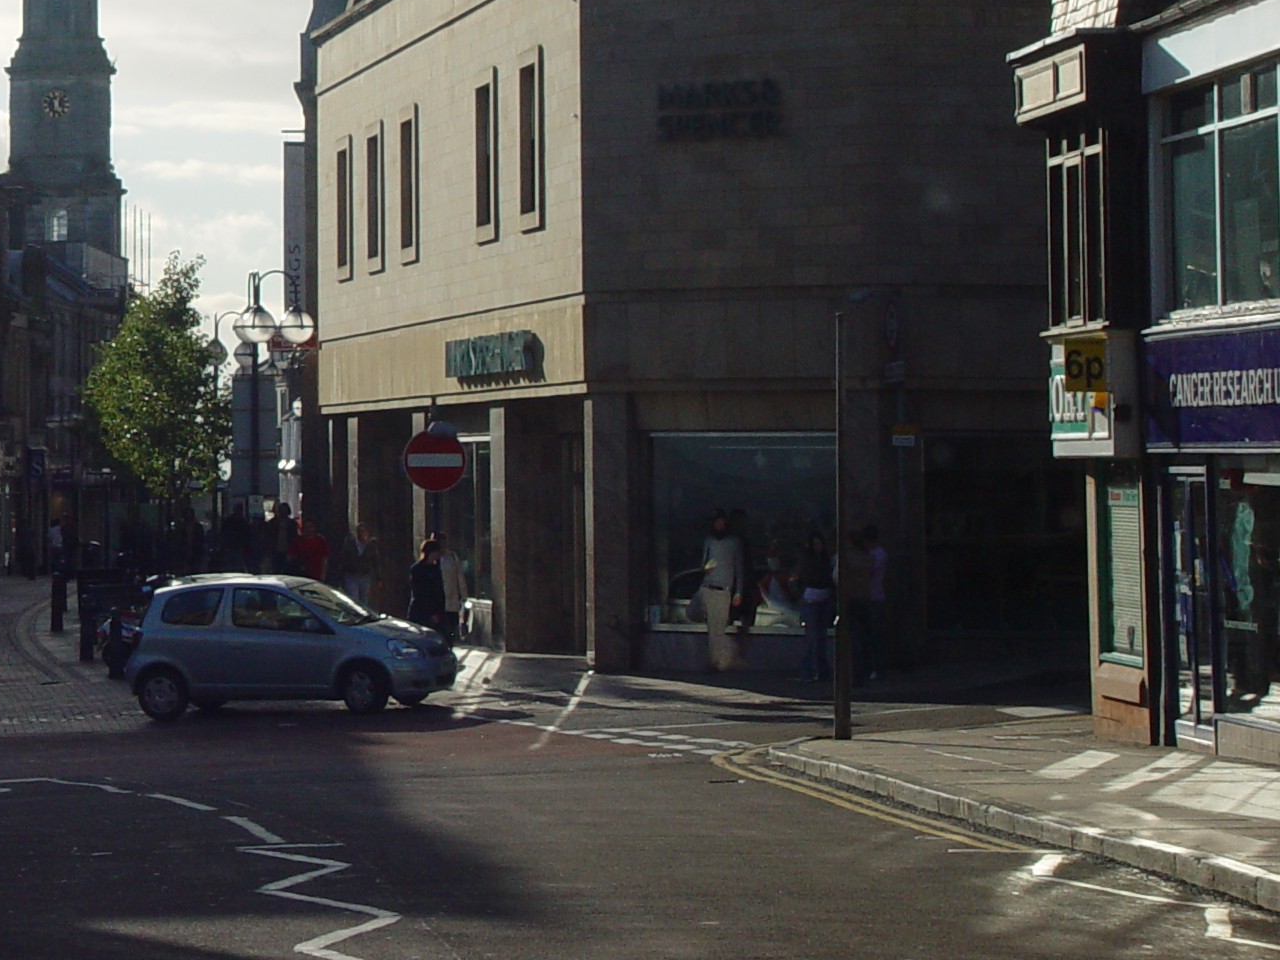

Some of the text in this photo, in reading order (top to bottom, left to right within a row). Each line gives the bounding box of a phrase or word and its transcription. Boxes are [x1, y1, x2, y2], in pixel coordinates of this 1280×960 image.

[1065, 349, 1104, 388] 6p
[1169, 372, 1212, 407] CANCER
[1212, 368, 1274, 406] RESEARCH
